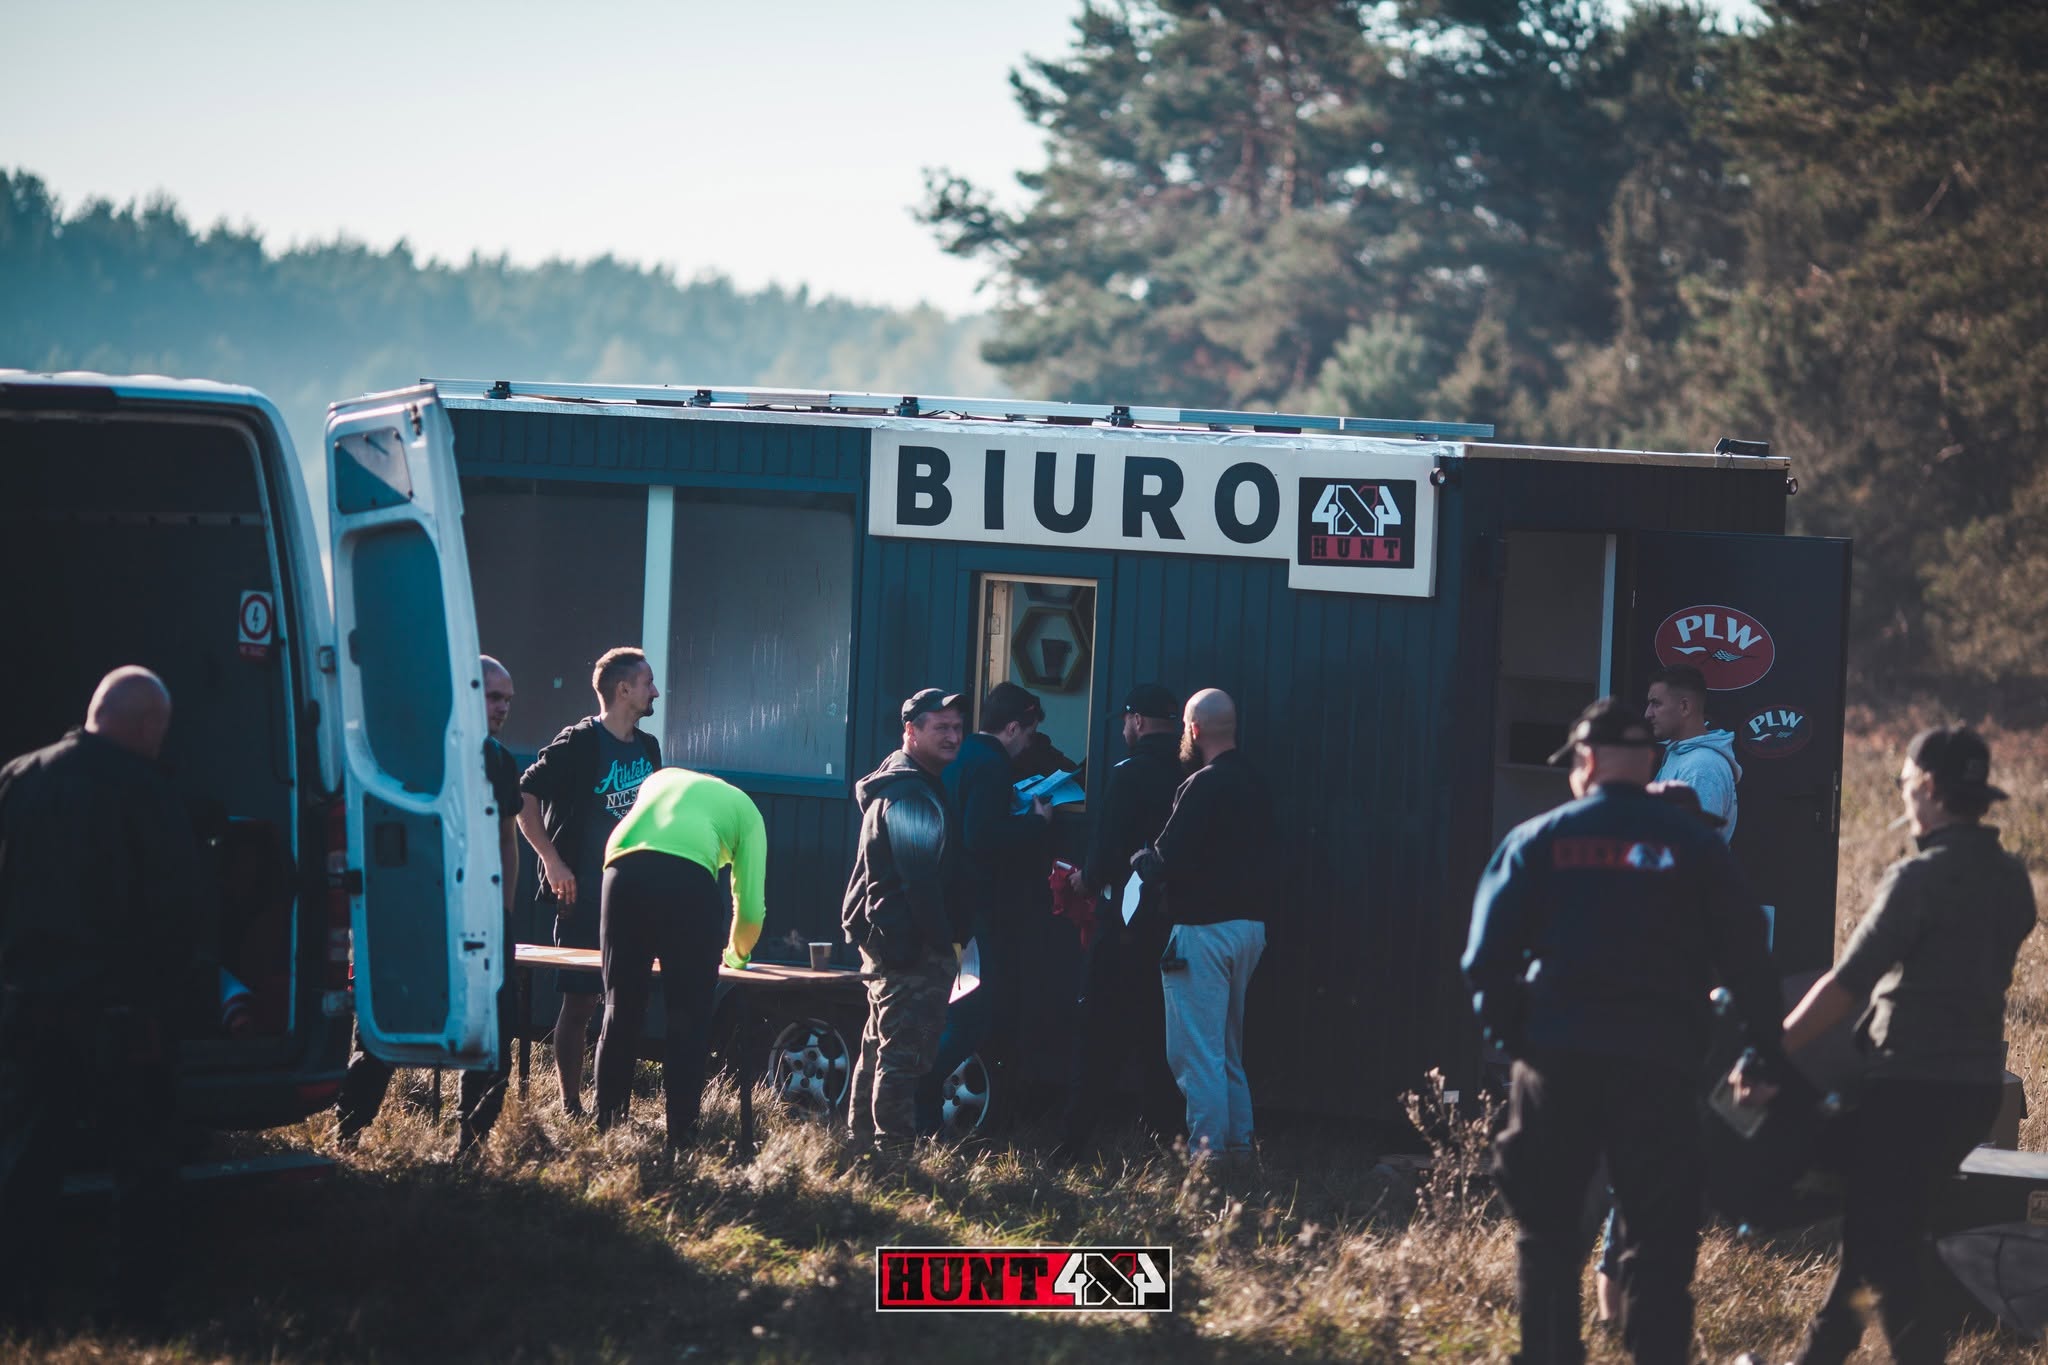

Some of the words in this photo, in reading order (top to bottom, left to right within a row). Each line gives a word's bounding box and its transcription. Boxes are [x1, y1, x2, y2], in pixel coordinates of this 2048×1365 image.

[896, 445, 1281, 544] BIURO
[1313, 537, 1399, 560] HUNT
[1675, 613, 1763, 650] PLW
[1748, 710, 1803, 734] PLW
